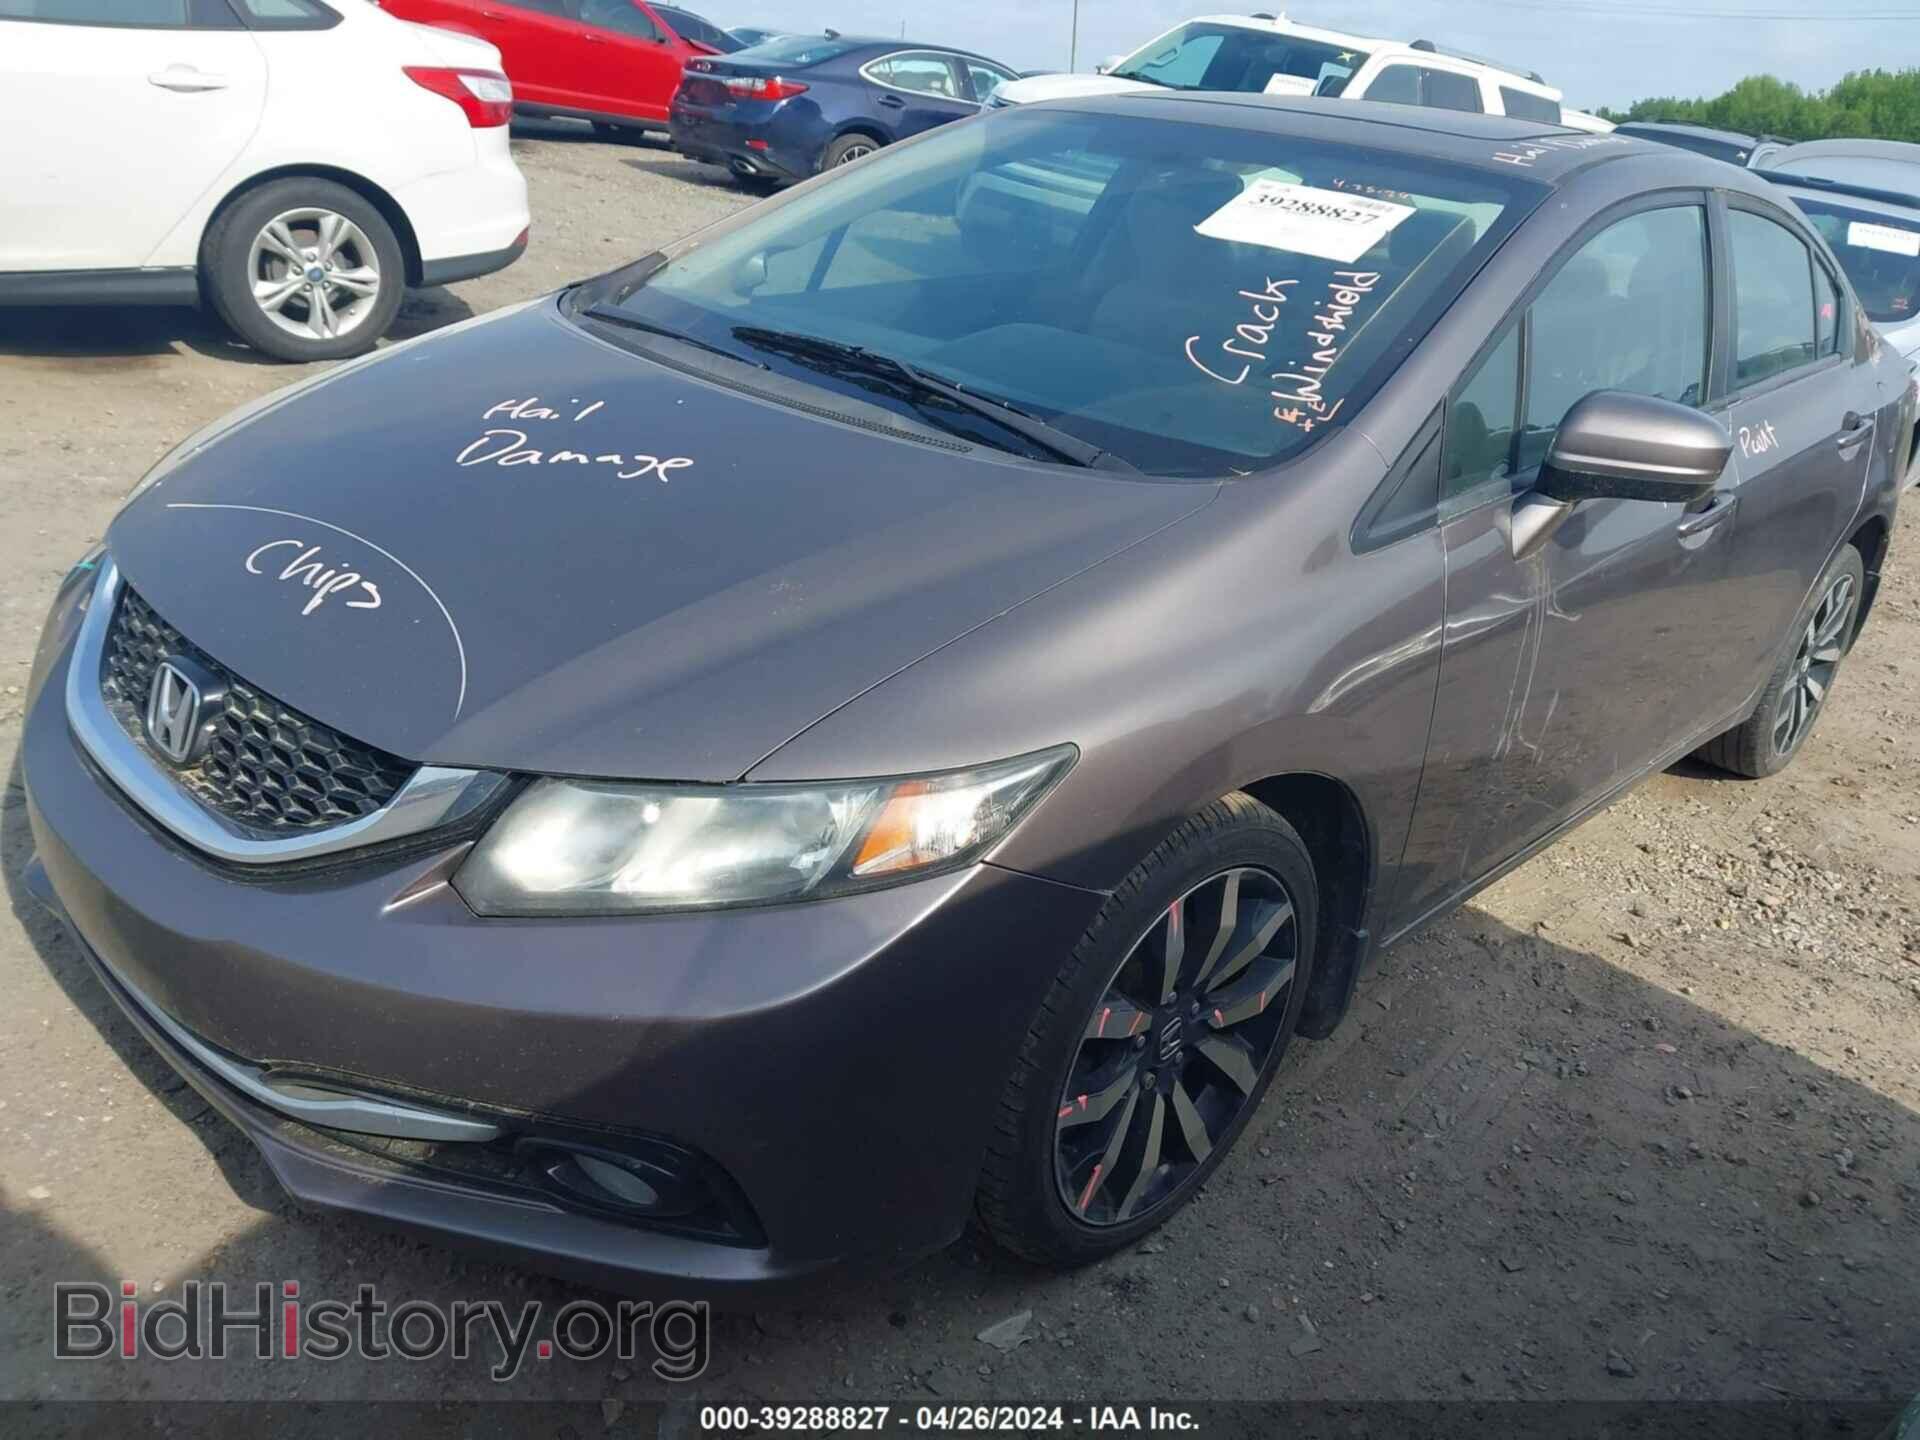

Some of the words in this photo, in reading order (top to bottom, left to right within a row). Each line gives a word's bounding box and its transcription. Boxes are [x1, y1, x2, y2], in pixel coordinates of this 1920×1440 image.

[1185, 275, 1300, 385] Crack
[1271, 270, 1381, 402] Windshield
[482, 397, 605, 422] Hail
[456, 429, 693, 482] Damage
[246, 540, 381, 615] Chips
